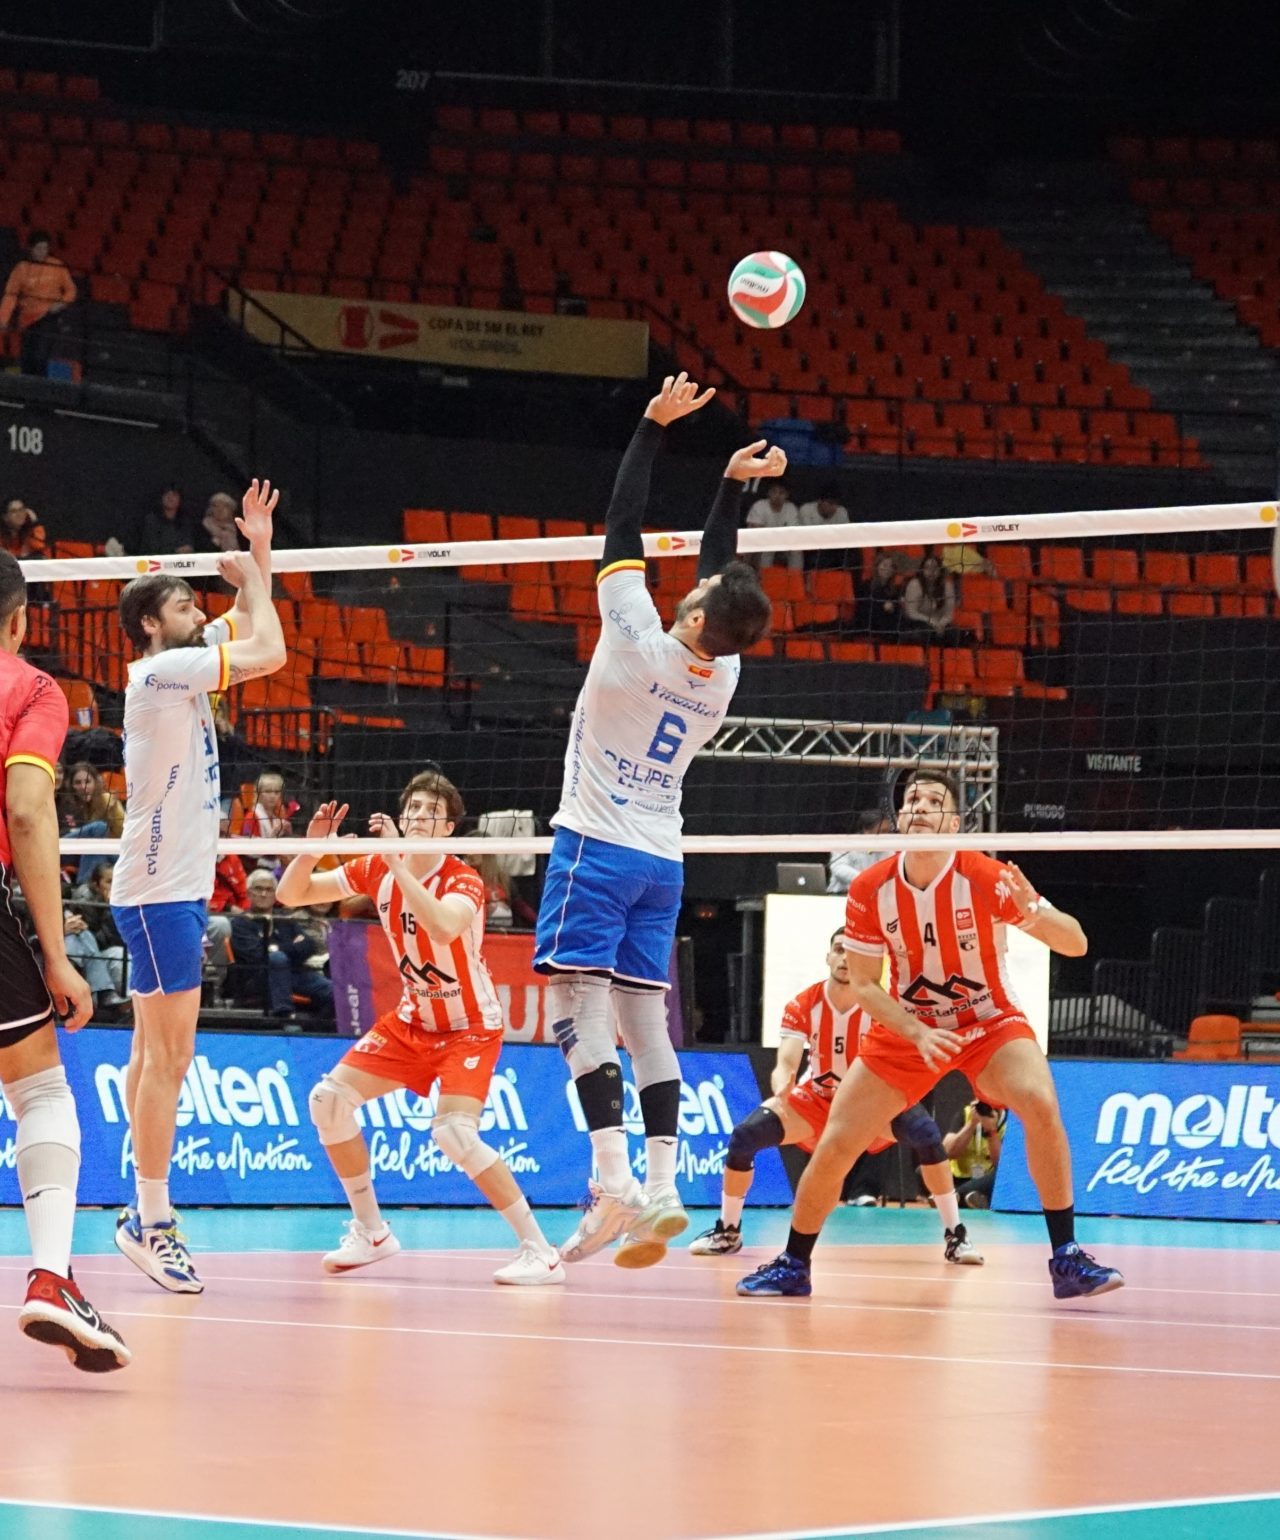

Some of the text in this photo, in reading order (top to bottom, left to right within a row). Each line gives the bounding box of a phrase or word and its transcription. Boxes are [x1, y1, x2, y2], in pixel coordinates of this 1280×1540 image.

[396, 70, 430, 90] 207
[429, 317, 463, 332] COPA
[522, 323, 546, 337] REY
[8, 424, 44, 455] 108
[646, 710, 687, 765] 6
[1086, 753, 1142, 772] VISITANTE
[400, 911, 417, 935] 15
[923, 922, 937, 947] 4
[834, 1036, 845, 1055] 5
[1095, 1084, 1280, 1150] molt
[171, 1135, 214, 1176] the
[1086, 1146, 1171, 1194] feel
[1160, 1155, 1224, 1193] the
